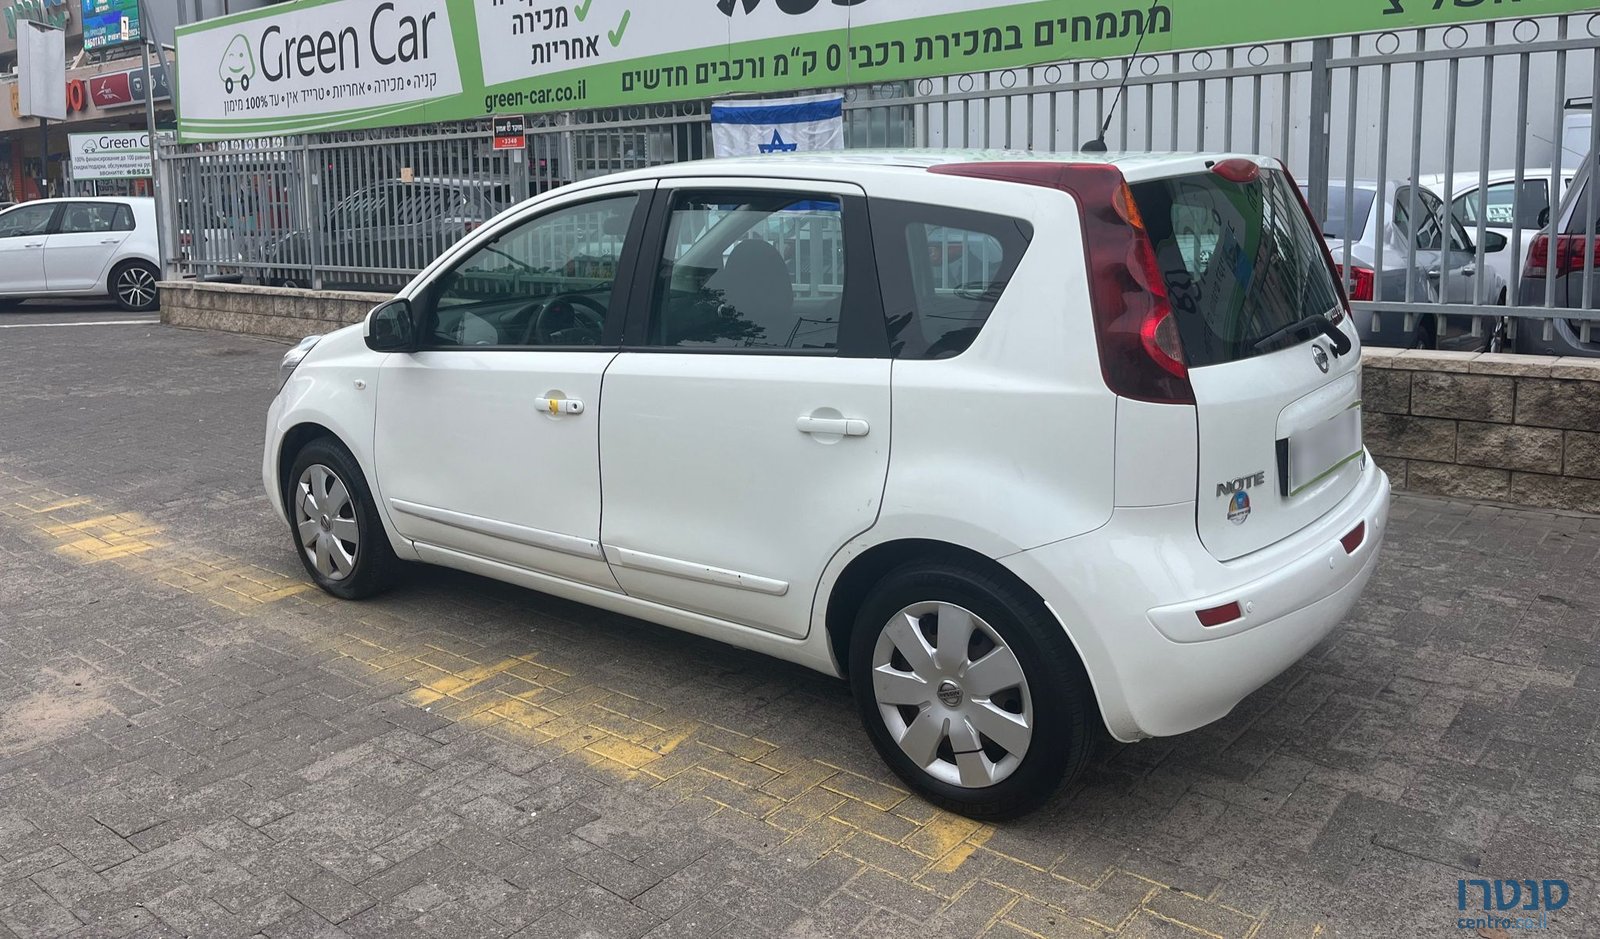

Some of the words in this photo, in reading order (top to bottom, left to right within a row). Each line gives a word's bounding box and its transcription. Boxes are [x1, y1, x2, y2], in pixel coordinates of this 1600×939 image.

[512, 6, 568, 35] מכירה
[1034, 5, 1171, 47] מתמחים
[260, 25, 360, 82] Green
[370, 2, 436, 65] Car
[531, 35, 599, 65] אחריות
[849, 40, 905, 69] רכבי
[914, 25, 1023, 62] במכירת
[695, 56, 765, 84] ורכבים
[826, 43, 841, 72] 0
[332, 82, 365, 99] אחריות
[374, 77, 404, 94] מכירה
[413, 72, 437, 92] קניה
[621, 65, 688, 92] חדשים
[224, 99, 243, 116] מימון
[246, 96, 268, 110] 100%
[269, 94, 280, 107] עד
[286, 90, 298, 109] אין
[301, 87, 325, 102] טרייד
[485, 79, 586, 113] green-car.co.il
[99, 136, 137, 149] Green
[1216, 471, 1264, 497] NOTE
